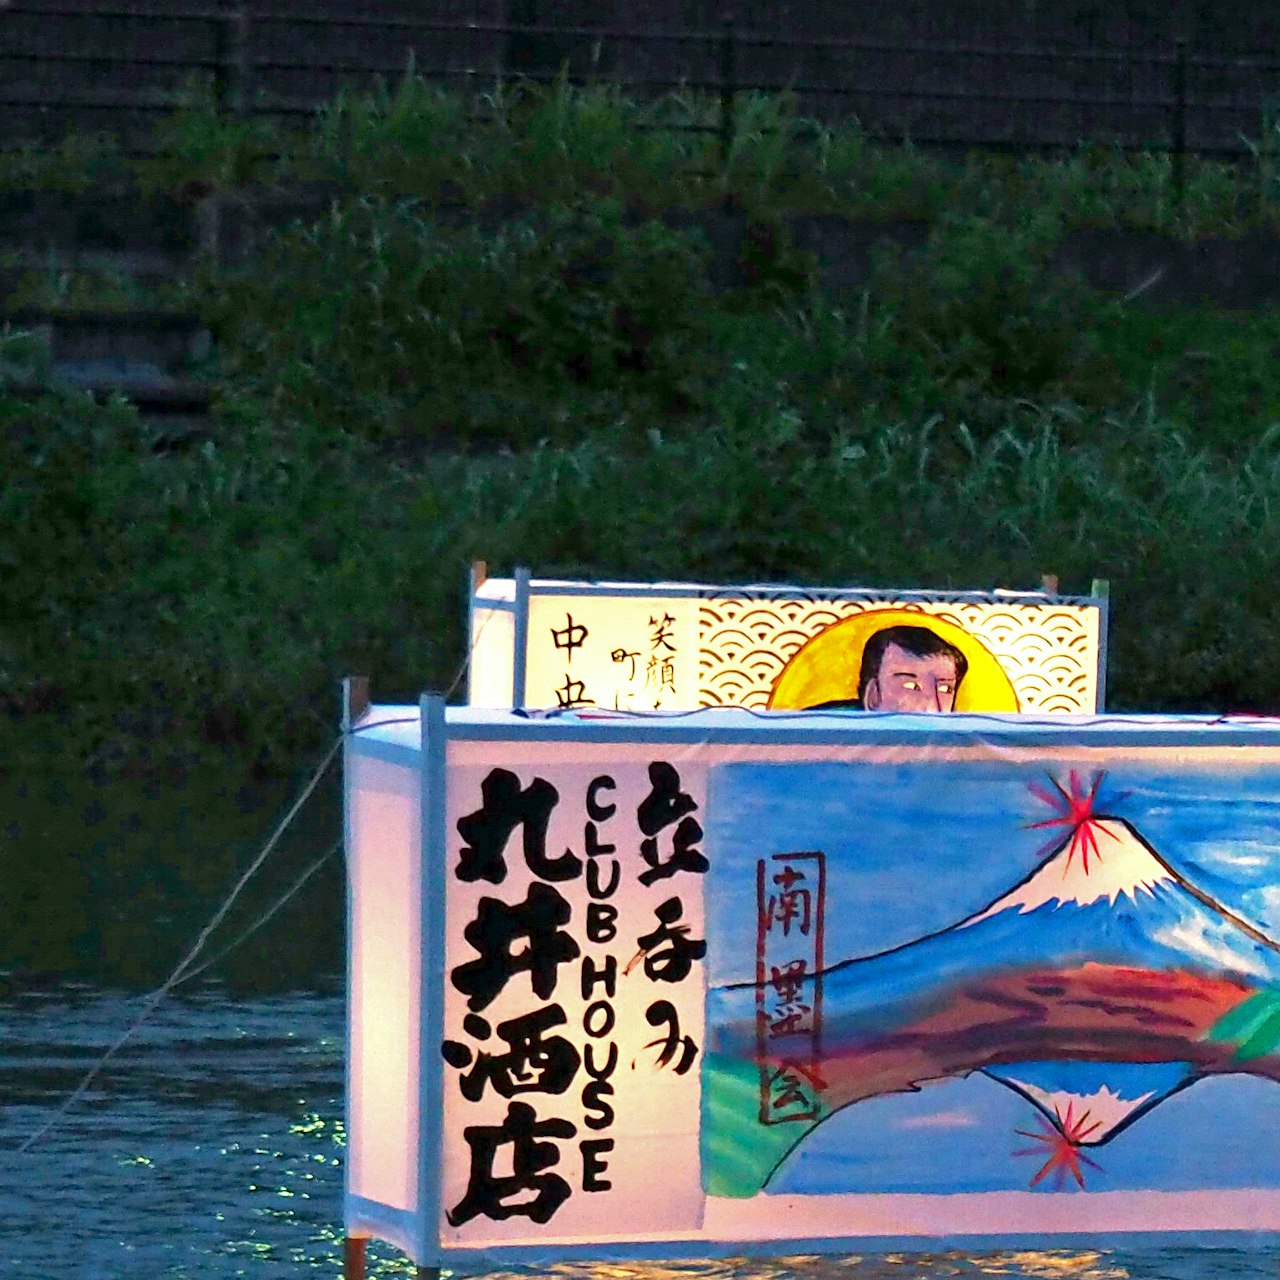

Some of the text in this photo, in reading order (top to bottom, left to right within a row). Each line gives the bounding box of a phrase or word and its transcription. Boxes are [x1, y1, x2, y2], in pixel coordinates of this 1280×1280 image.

[646, 612, 678, 710] 笑顔
[441, 767, 583, 1227] 丸井酒店
[632, 761, 709, 1076] 立呑み
